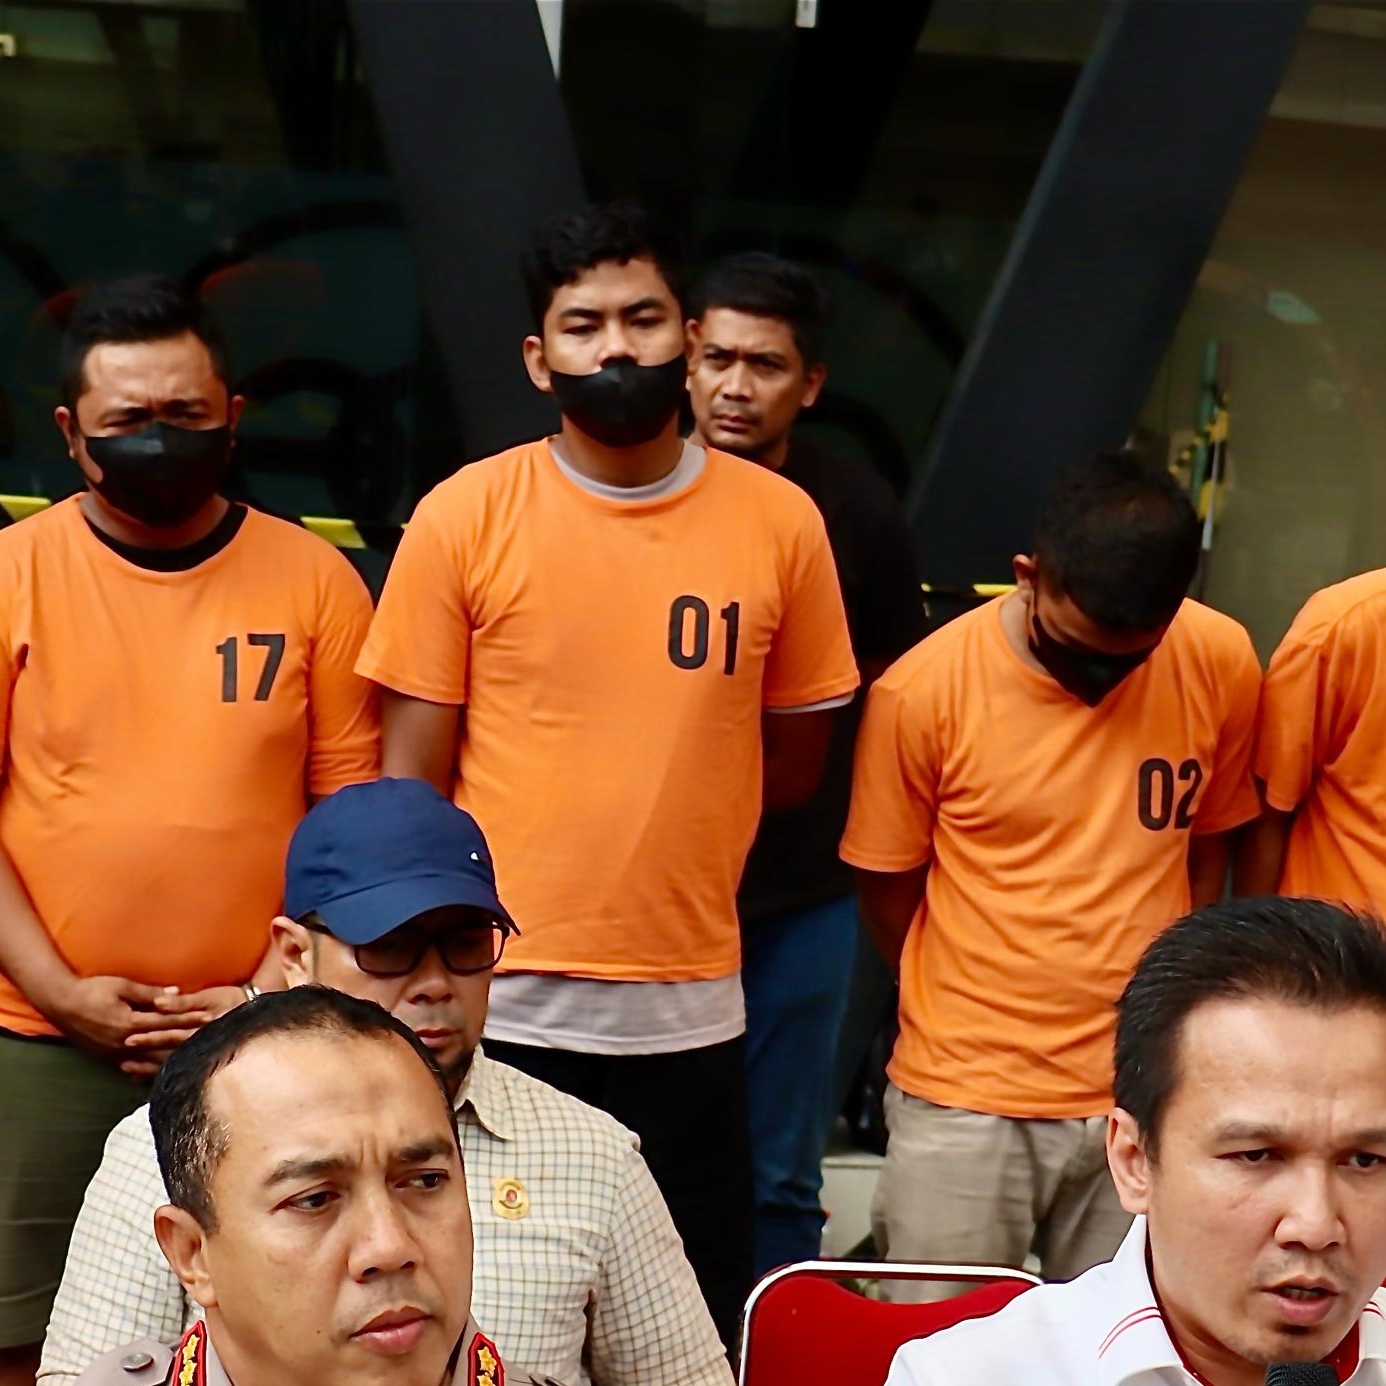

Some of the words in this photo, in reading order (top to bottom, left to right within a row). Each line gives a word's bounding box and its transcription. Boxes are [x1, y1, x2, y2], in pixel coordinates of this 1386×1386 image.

[215, 632, 286, 704] 17
[667, 594, 741, 676] 01
[1136, 755, 1204, 831] 02
